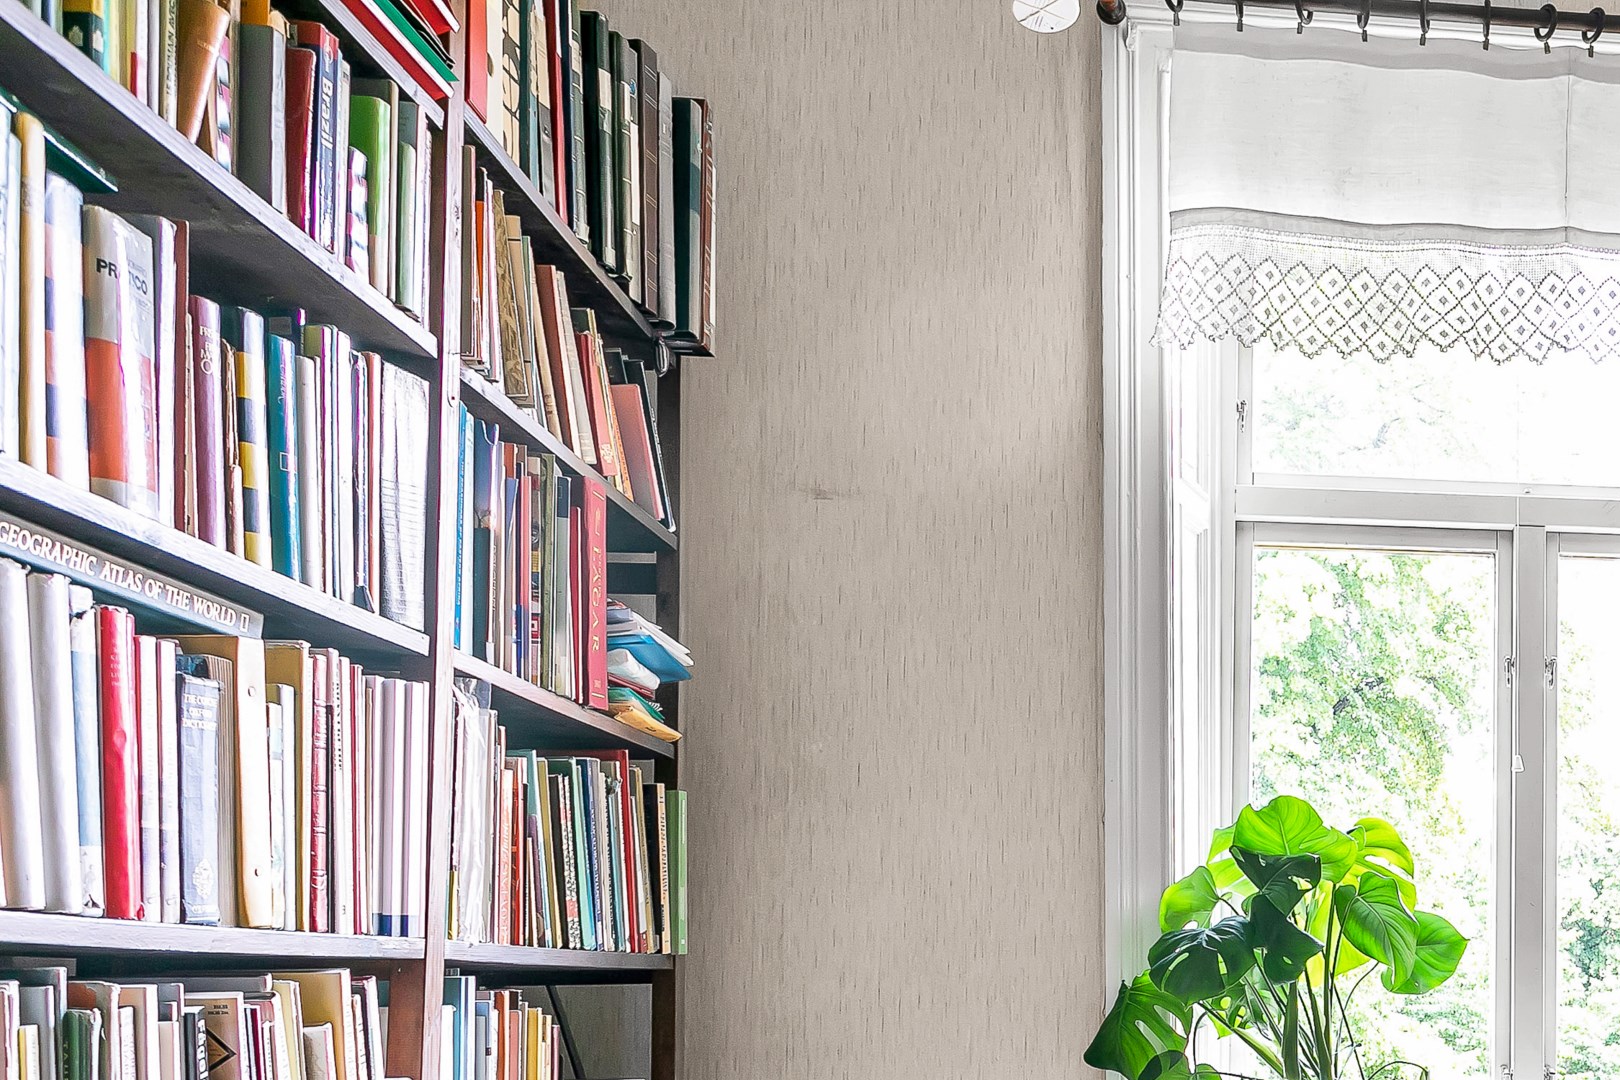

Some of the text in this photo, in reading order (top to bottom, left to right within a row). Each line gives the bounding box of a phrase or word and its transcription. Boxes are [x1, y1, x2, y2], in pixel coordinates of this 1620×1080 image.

[321, 77, 334, 150] Brazil
[96, 257, 149, 296] PRTICO
[0, 522, 237, 625] GEOGRAPHIC ATLAS OF THE WORLD
